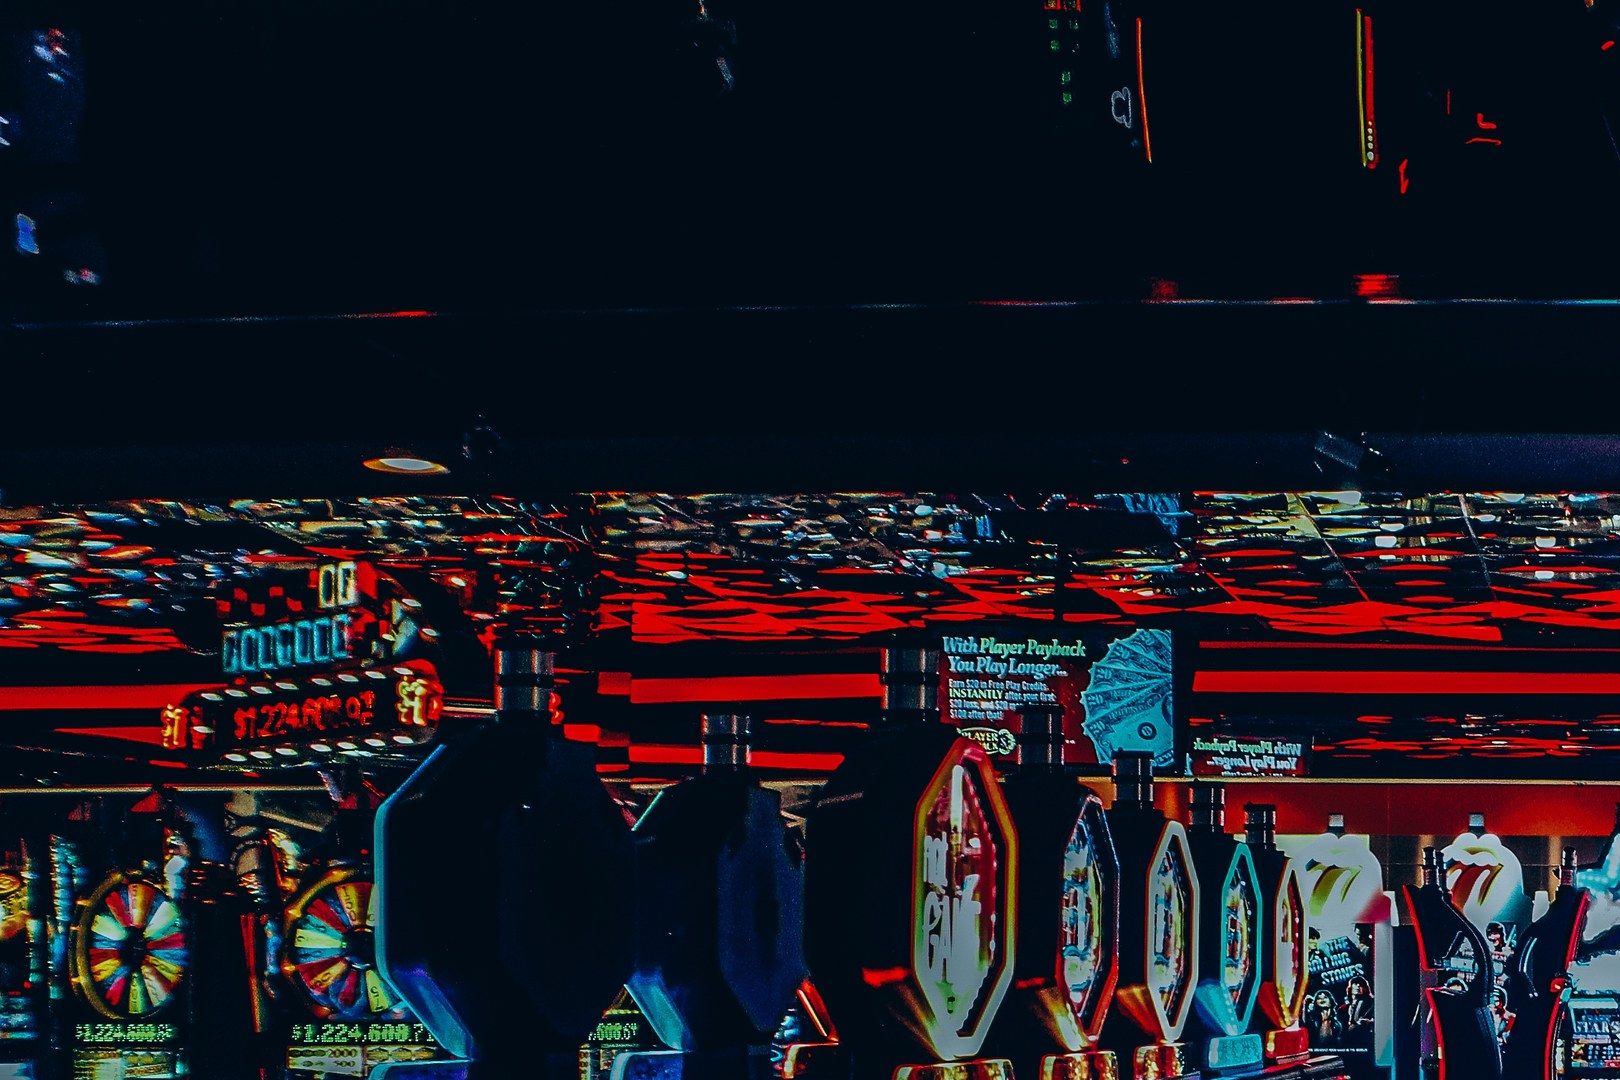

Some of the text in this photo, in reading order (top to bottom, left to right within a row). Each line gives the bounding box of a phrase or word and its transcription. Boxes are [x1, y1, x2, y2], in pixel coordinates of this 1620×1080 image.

[943, 636, 1086, 660] With Player Payback
[948, 655, 974, 673] You
[977, 656, 1007, 679] Play
[949, 688, 1003, 699] INSTANTLY
[1321, 963, 1365, 985] STONES
